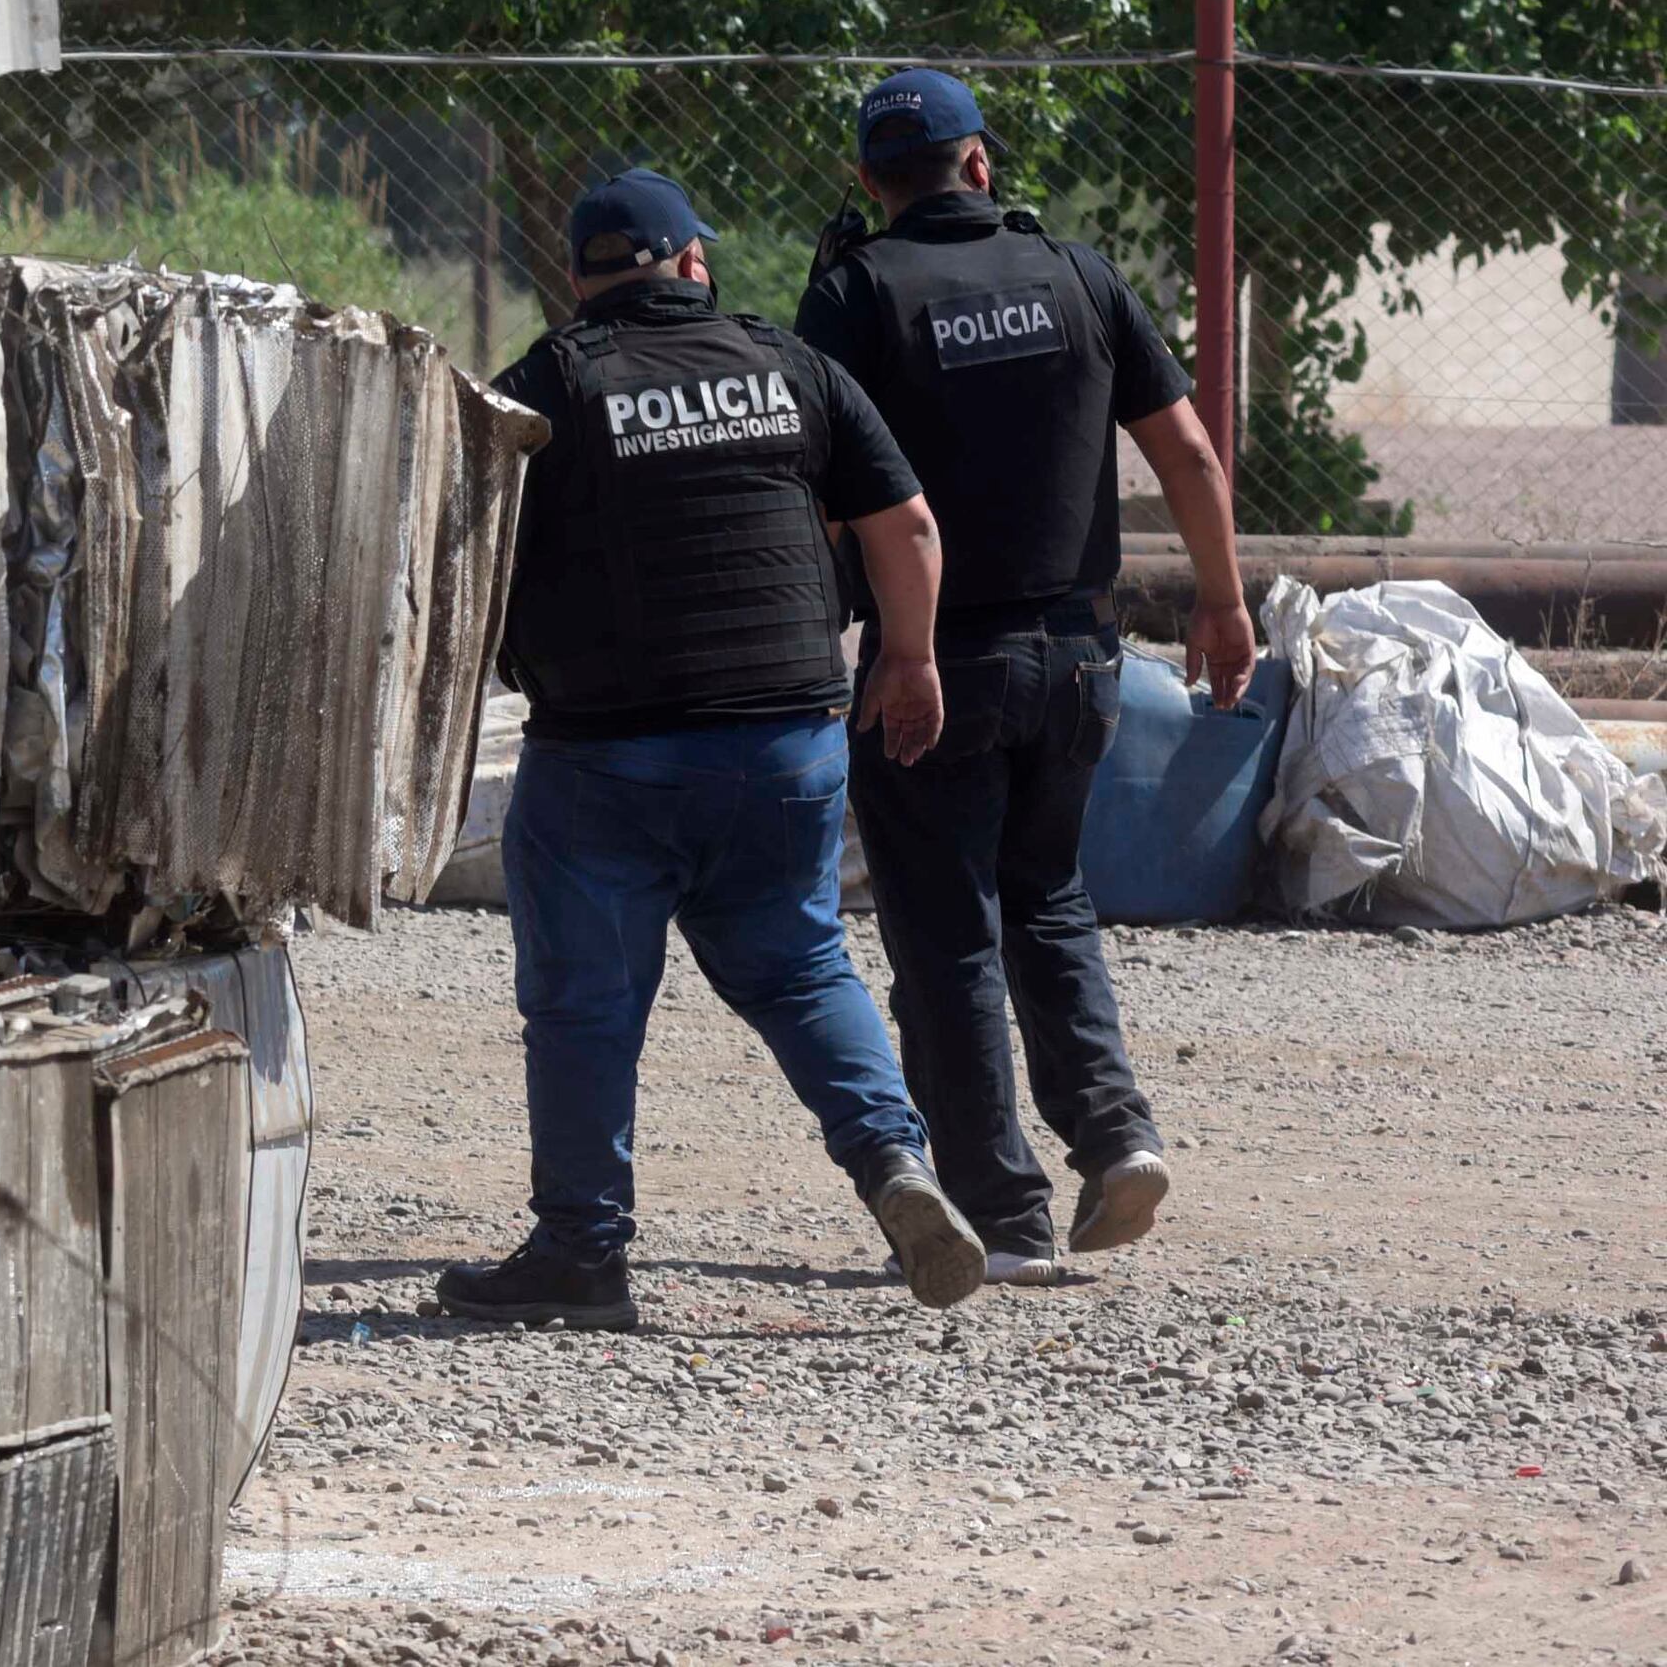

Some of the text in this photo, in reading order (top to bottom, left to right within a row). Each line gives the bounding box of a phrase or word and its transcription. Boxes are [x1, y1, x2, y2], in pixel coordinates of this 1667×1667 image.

[932, 302, 1054, 349] POLICIA
[606, 370, 797, 435] POLICIA
[614, 413, 801, 458] INVESTIGACIONES
